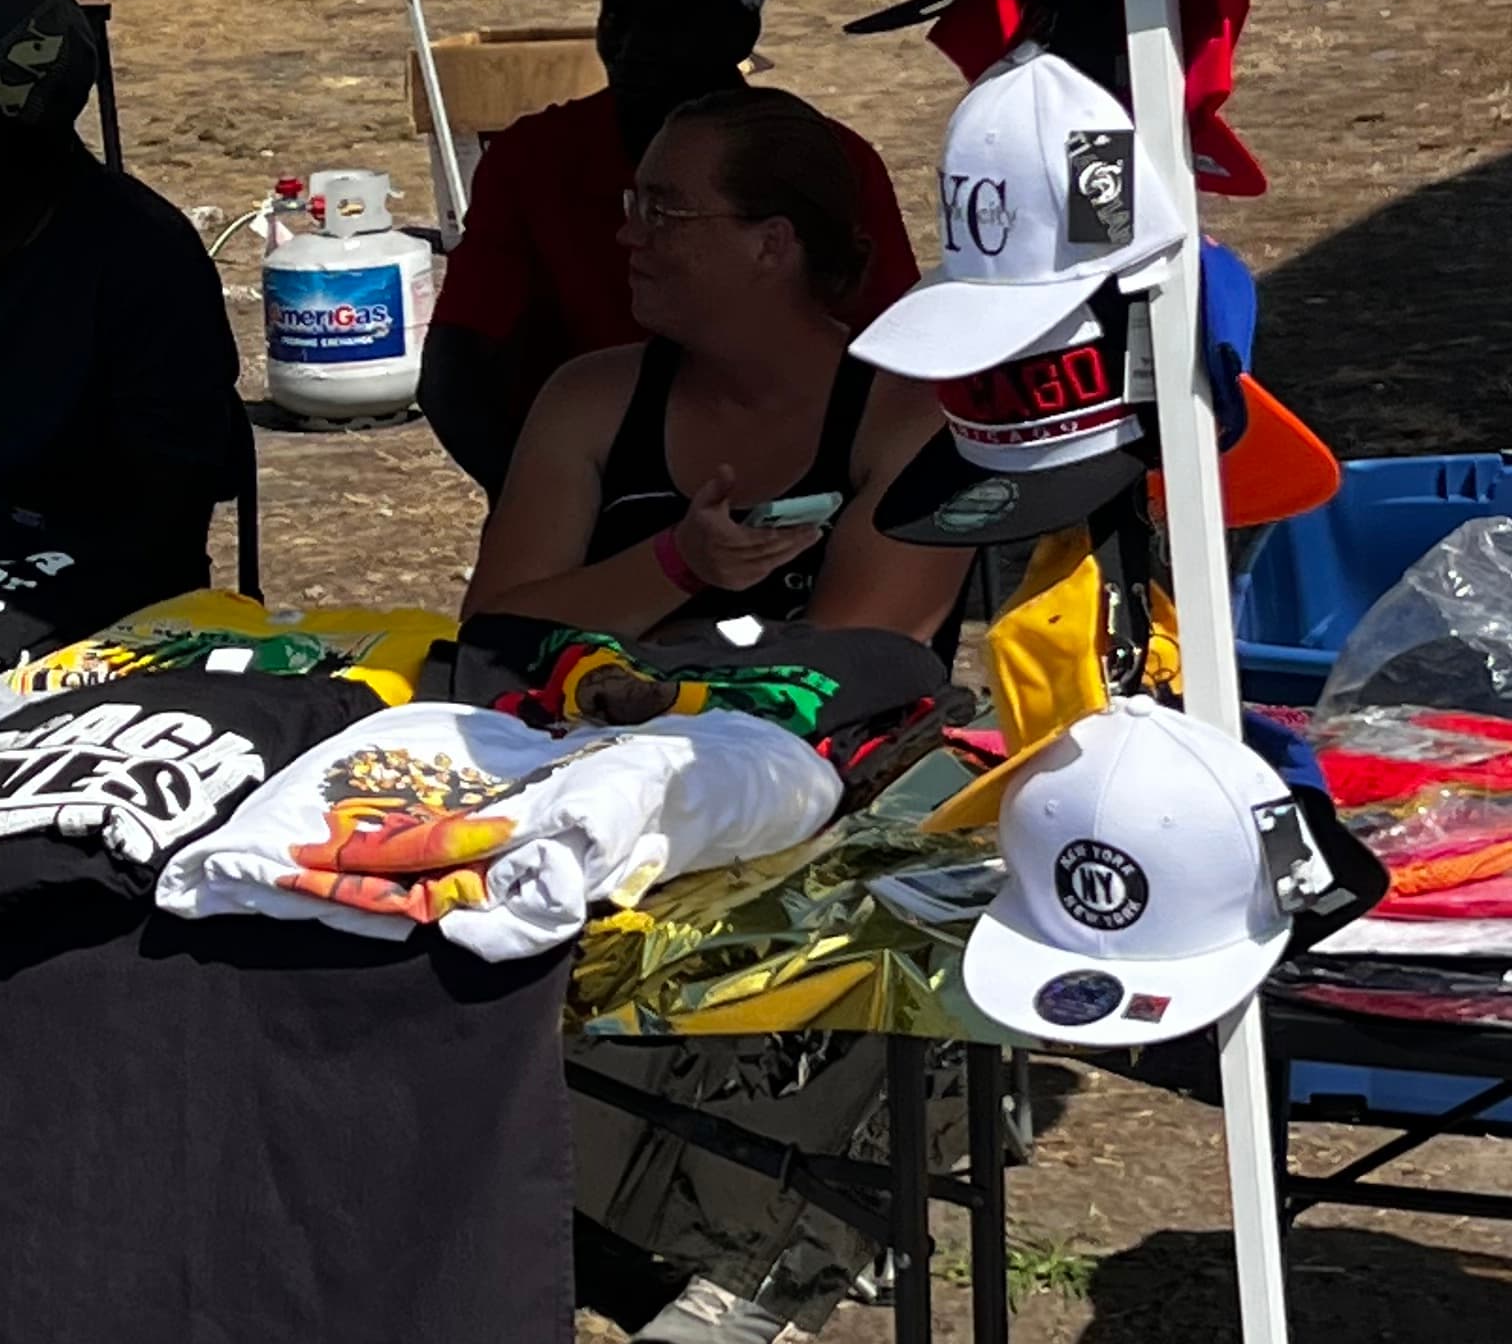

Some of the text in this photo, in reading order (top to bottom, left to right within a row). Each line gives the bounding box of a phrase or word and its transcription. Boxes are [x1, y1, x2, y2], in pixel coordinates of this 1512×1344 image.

[264, 304, 390, 329] AmeriGas
[1092, 847, 1136, 876] YORK
[1079, 867, 1113, 905] NY
[1103, 899, 1141, 928] YORK
